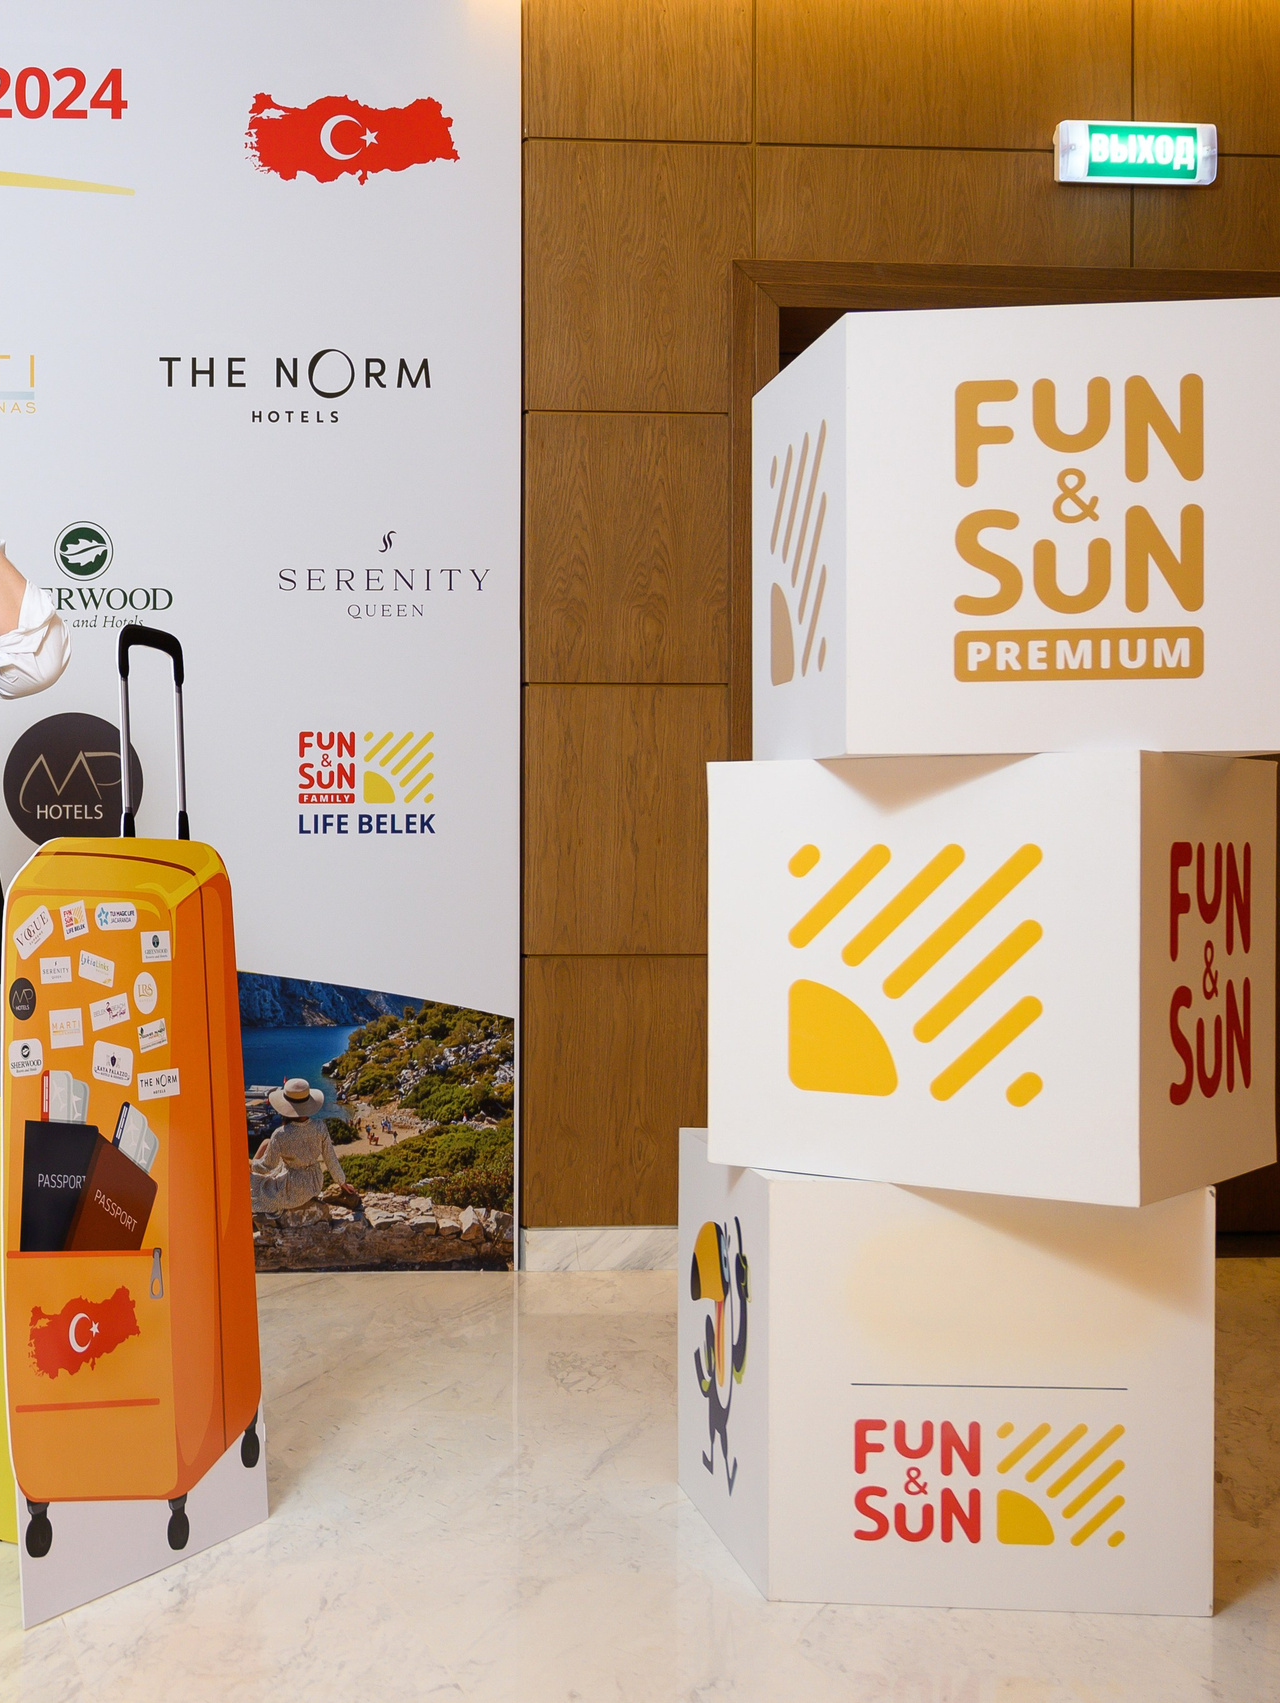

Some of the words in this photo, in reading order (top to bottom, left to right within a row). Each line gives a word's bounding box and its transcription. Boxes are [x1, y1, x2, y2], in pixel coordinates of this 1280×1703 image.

[1091, 132, 1196, 170] ВЫХОД
[159, 357, 246, 388] THE
[276, 348, 432, 399] NORM
[251, 410, 340, 424] HOTELS
[954, 373, 1204, 487] FUN
[1052, 467, 1100, 523] &
[954, 503, 1204, 616] SUN
[278, 568, 491, 592] SERENITY
[40, 587, 173, 610] RWOOD
[347, 604, 425, 619] QUEEN
[72, 615, 98, 628] and
[102, 615, 144, 628] Hotels
[967, 637, 1190, 671] PREMIUM
[299, 731, 356, 758] FUN
[320, 752, 332, 768] &
[299, 762, 356, 789] SUN
[36, 803, 103, 820] HOTELS
[303, 794, 351, 802] FAMILY
[298, 814, 349, 834] LIFE
[357, 813, 436, 834] BELEK
[1170, 842, 1251, 962] FUN
[16, 911, 48, 946] VOGUE
[66, 926, 74, 934] LIFE
[1202, 940, 1218, 999] &
[138, 984, 153, 997] LRS
[52, 1021, 80, 1029] MARTI
[1169, 976, 1251, 1106] SUN
[11, 1059, 41, 1069] SHERWOOD
[140, 1078, 152, 1087] THE
[155, 1074, 177, 1087] NORM
[38, 1173, 86, 1189] PASSPORT
[94, 1189, 137, 1232] PASSPORT
[854, 1418, 981, 1476] FUN
[904, 1466, 928, 1496] &
[853, 1485, 981, 1543] SUN
